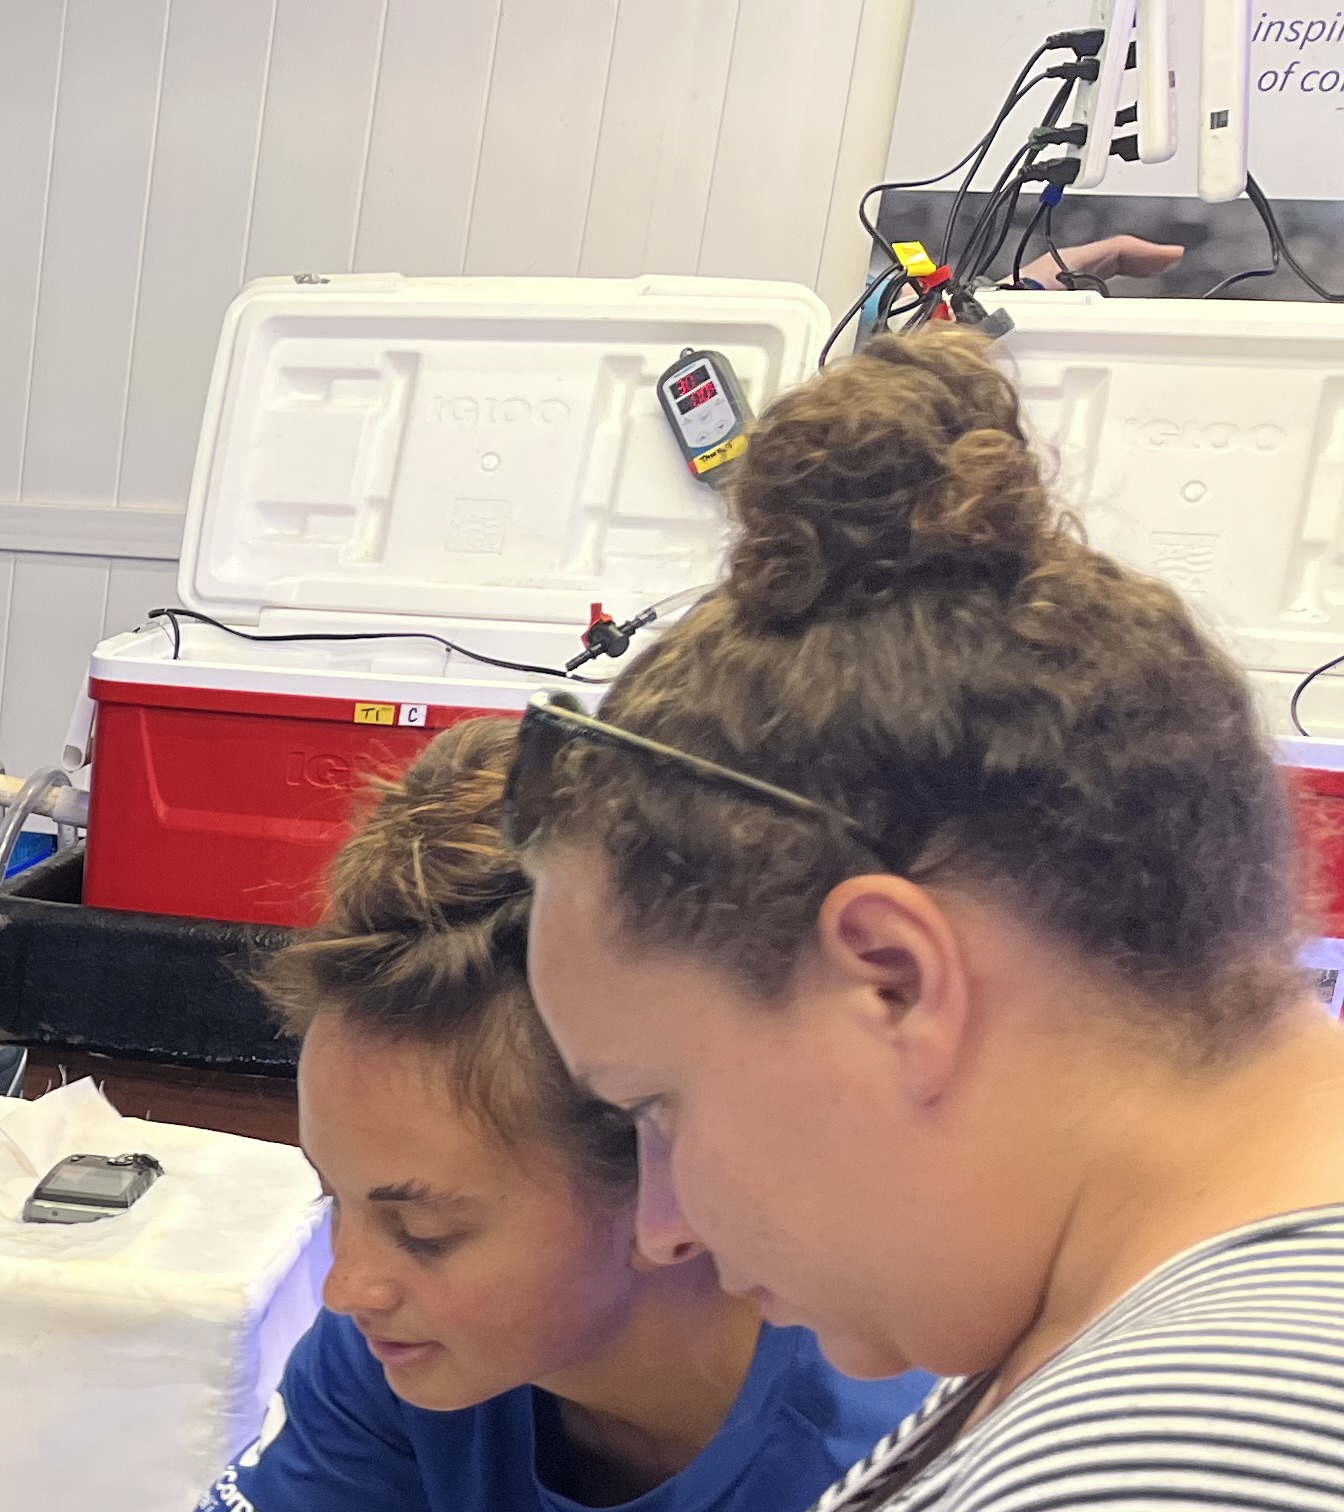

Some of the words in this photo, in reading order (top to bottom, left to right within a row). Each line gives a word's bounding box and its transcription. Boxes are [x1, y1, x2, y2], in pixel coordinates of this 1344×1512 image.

[1257, 61, 1301, 92] of
[1300, 70, 1344, 92] co
[407, 707, 419, 723] C
